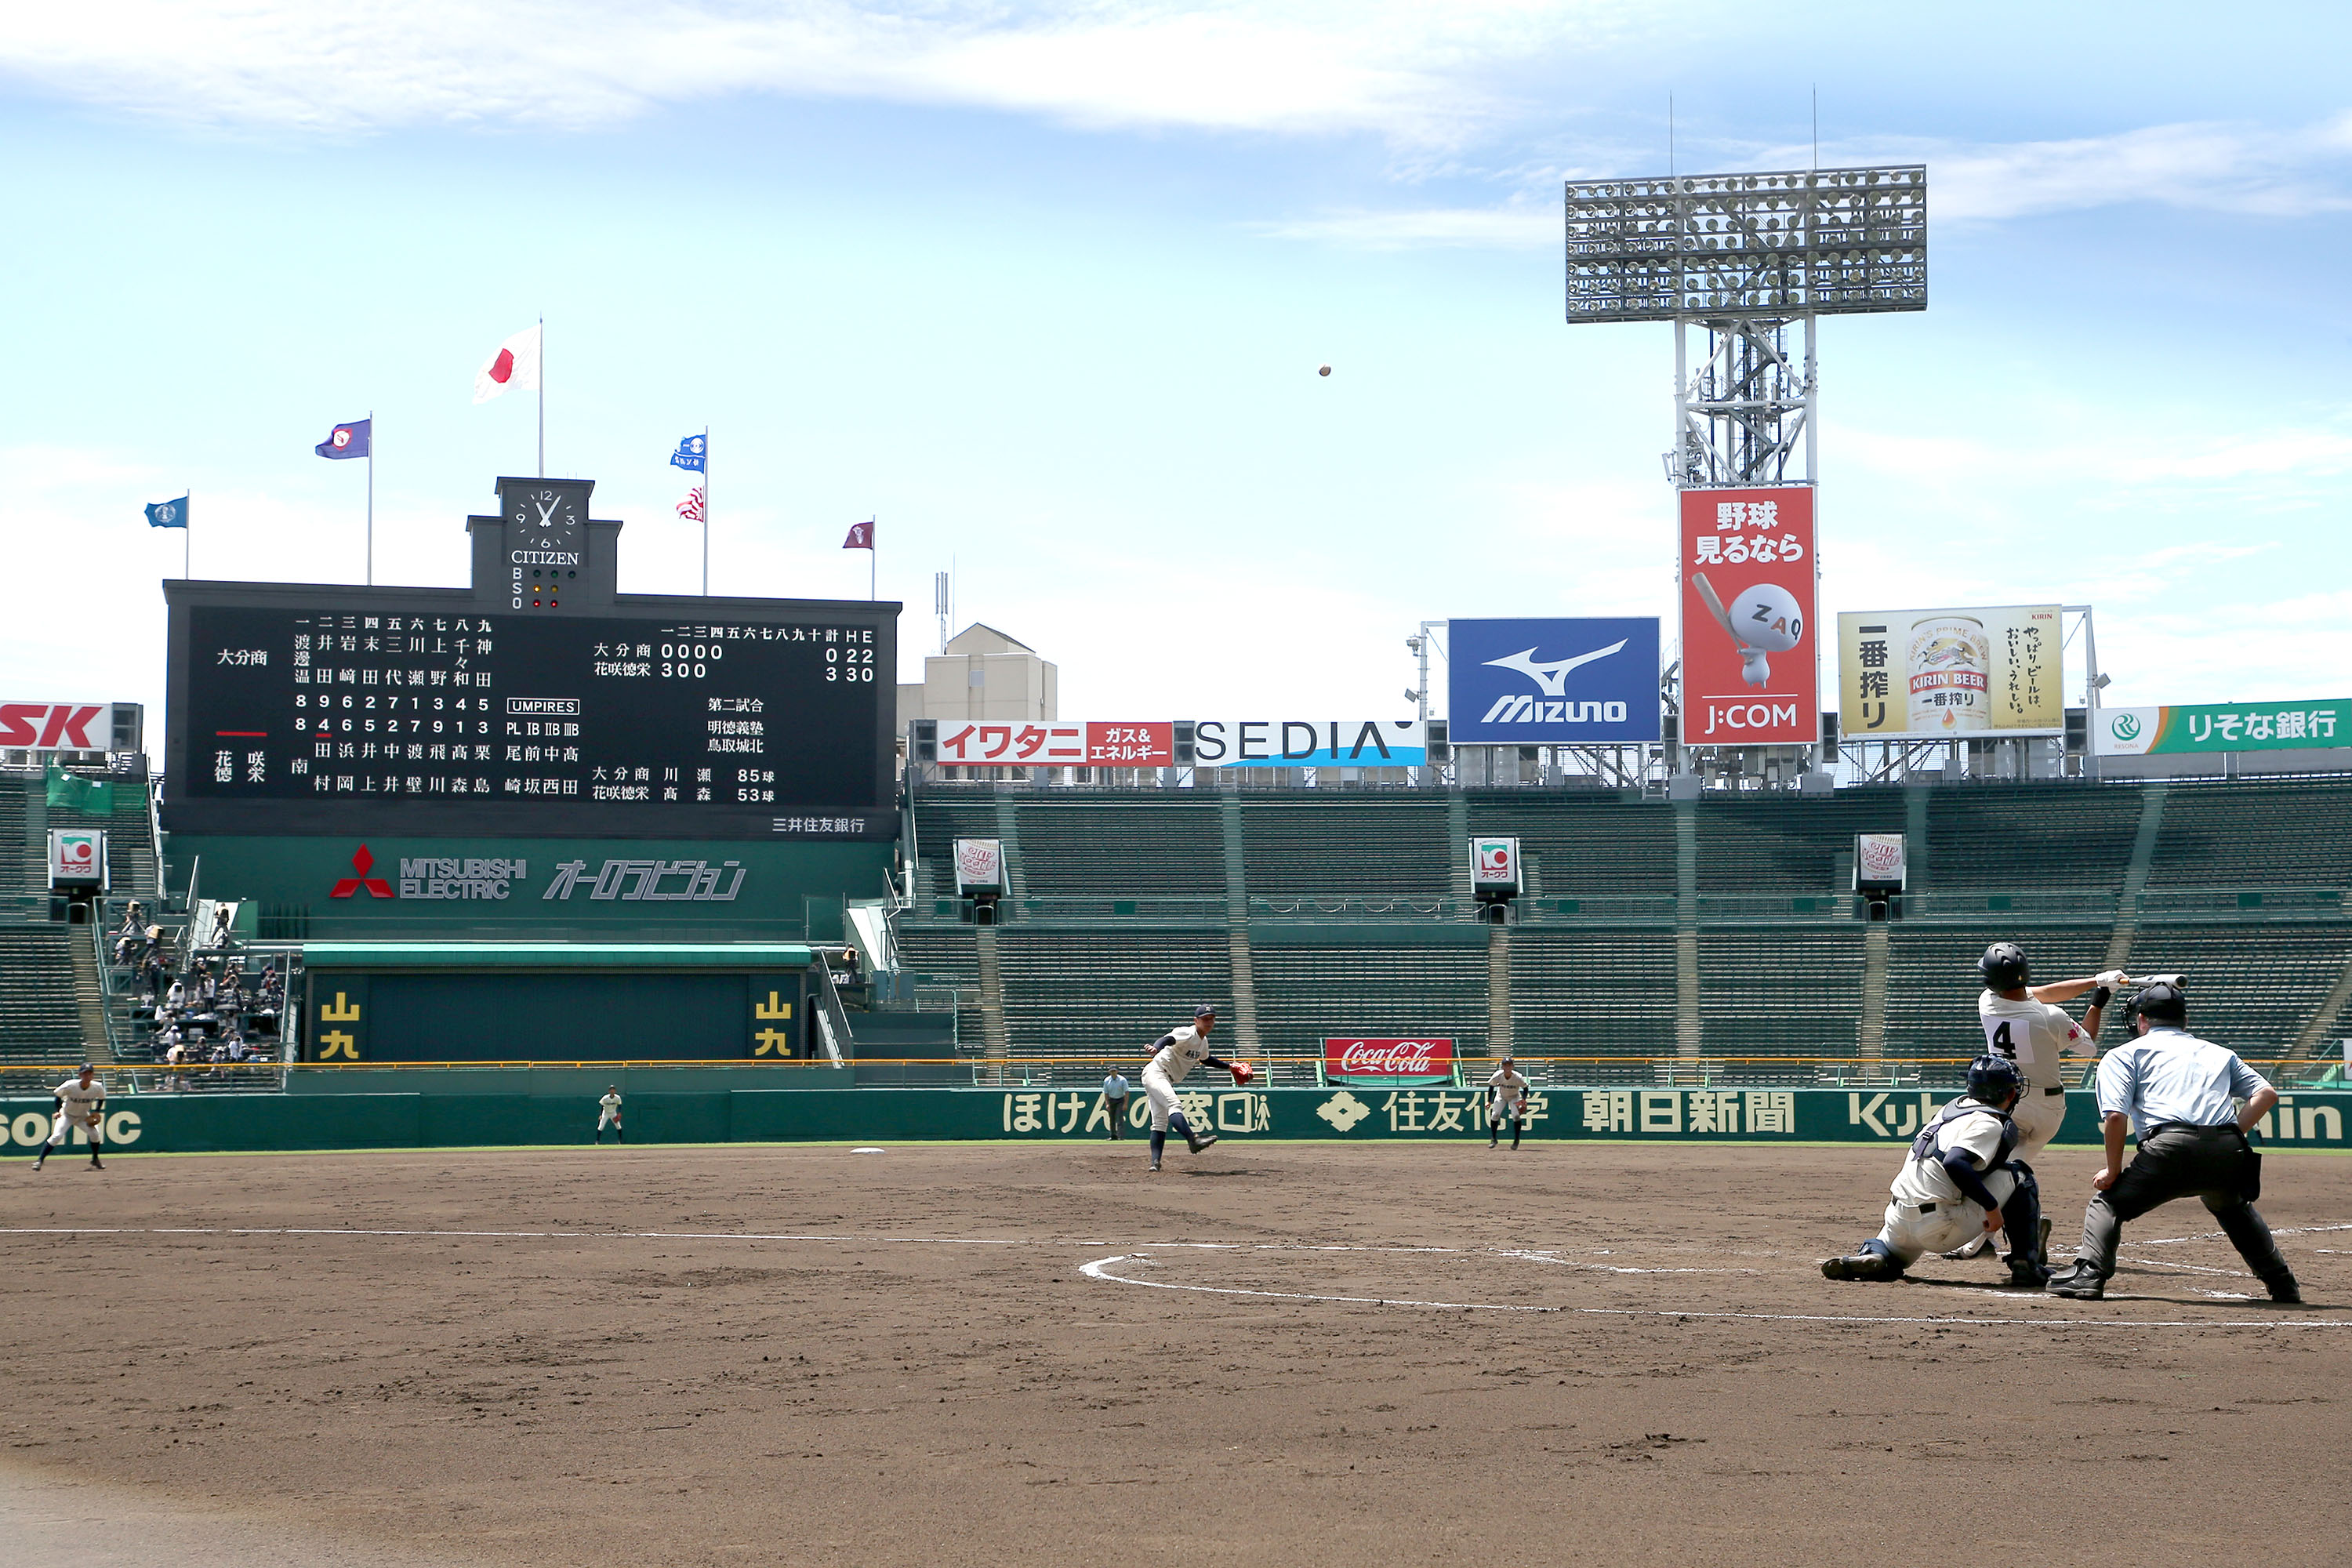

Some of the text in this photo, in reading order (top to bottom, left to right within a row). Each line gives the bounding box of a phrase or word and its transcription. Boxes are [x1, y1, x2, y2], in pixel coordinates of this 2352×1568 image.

[540, 491, 553, 501] 12
[516, 514, 575, 525] 9 3
[1717, 501, 1778, 531] 野球
[540, 538, 551, 549] 6
[1693, 534, 1804, 565] 見るなら
[511, 550, 579, 564] CITIZEN
[513, 568, 522, 579] B
[513, 583, 522, 595] S
[319, 617, 332, 626] 二
[342, 616, 356, 629] 三
[365, 617, 379, 628] 四
[387, 618, 401, 630] 五
[411, 618, 423, 630] 六
[434, 619, 447, 630] 七
[456, 619, 469, 631] 八
[478, 619, 492, 632] 九
[1751, 604, 1801, 640] ZAQ
[677, 626, 690, 636] 二
[694, 626, 706, 637] 三
[711, 627, 723, 637] 四
[727, 627, 739, 638] 五
[743, 627, 756, 639] 六
[760, 628, 772, 639] 七
[775, 629, 788, 640] 八
[792, 629, 804, 641] 九
[808, 629, 821, 641] 十
[826, 630, 839, 642] 計
[846, 630, 857, 643] H
[863, 631, 873, 643] E
[218, 649, 267, 666] 大分商
[318, 635, 332, 684] 井田
[386, 637, 401, 684] 三代
[431, 638, 447, 686] 上野
[594, 643, 873, 663] 大分商 0 0 0 0 0 2 2
[476, 639, 492, 688] 神田
[594, 662, 873, 682] 花咲徳栄 3 0 0 3 3 0
[1859, 626, 1889, 728] 一番搾り
[1913, 673, 1985, 691] KIRIN BEER
[296, 695, 488, 711] 8 9 6 2 7 1 3 4 5
[512, 701, 575, 713] UMPIRES
[709, 697, 764, 713] 第二試合
[1922, 692, 1974, 706] 一番搾り
[296, 718, 488, 734] 8 4 6 5 2 7 9 1 3
[506, 722, 521, 735] PL
[708, 720, 764, 735] 明徳義塾
[1704, 703, 1797, 734] J:COM
[2189, 710, 2336, 742] りそな銀行
[708, 739, 764, 753] 鳥取城北
[942, 724, 1082, 759] イワタニ
[1105, 728, 1151, 744] ガス&
[1090, 744, 1167, 761] エネルギー
[292, 758, 308, 774] 南
[314, 742, 330, 791] 田村
[361, 742, 376, 791] 井上
[383, 743, 400, 792] 中井
[543, 746, 559, 794] 中西
[593, 767, 649, 781] 大分商
[593, 786, 649, 800] 花咲徳栄
[772, 817, 865, 833] 三井住友銀行
[400, 858, 526, 880] MITSUBISHI
[400, 879, 510, 899] ELECTRIC
[543, 859, 746, 901] オーロラビジョン
[320, 992, 360, 1059] 山九
[755, 991, 791, 1056] 山九
[1992, 1021, 2017, 1060] 4
[1341, 1041, 1436, 1073] Coca-Cola
[1582, 1091, 1795, 1134] 朝日新聞
